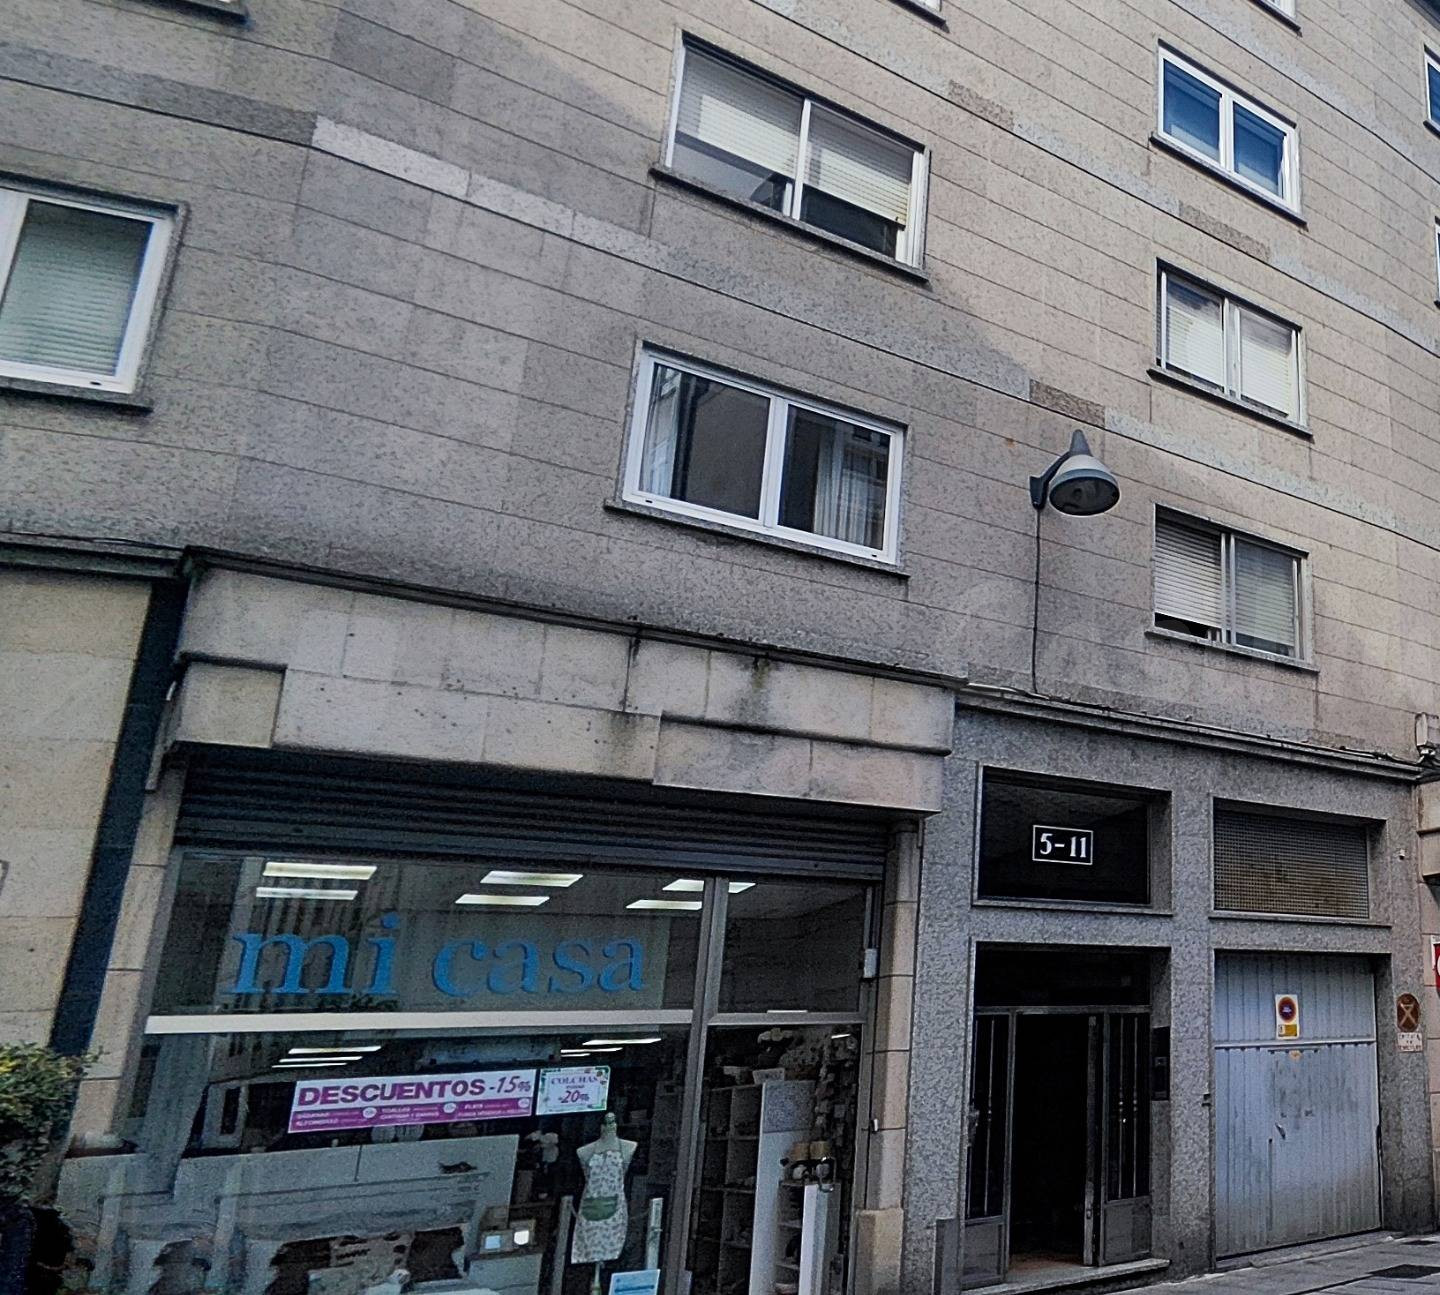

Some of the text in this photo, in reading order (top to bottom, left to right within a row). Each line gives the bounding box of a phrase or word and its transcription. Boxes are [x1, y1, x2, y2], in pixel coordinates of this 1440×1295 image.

[232, 912, 645, 997] mi casa
[297, 1075, 532, 1107] DESCUENTOS -15%
[551, 1074, 599, 1086] COLCHAS
